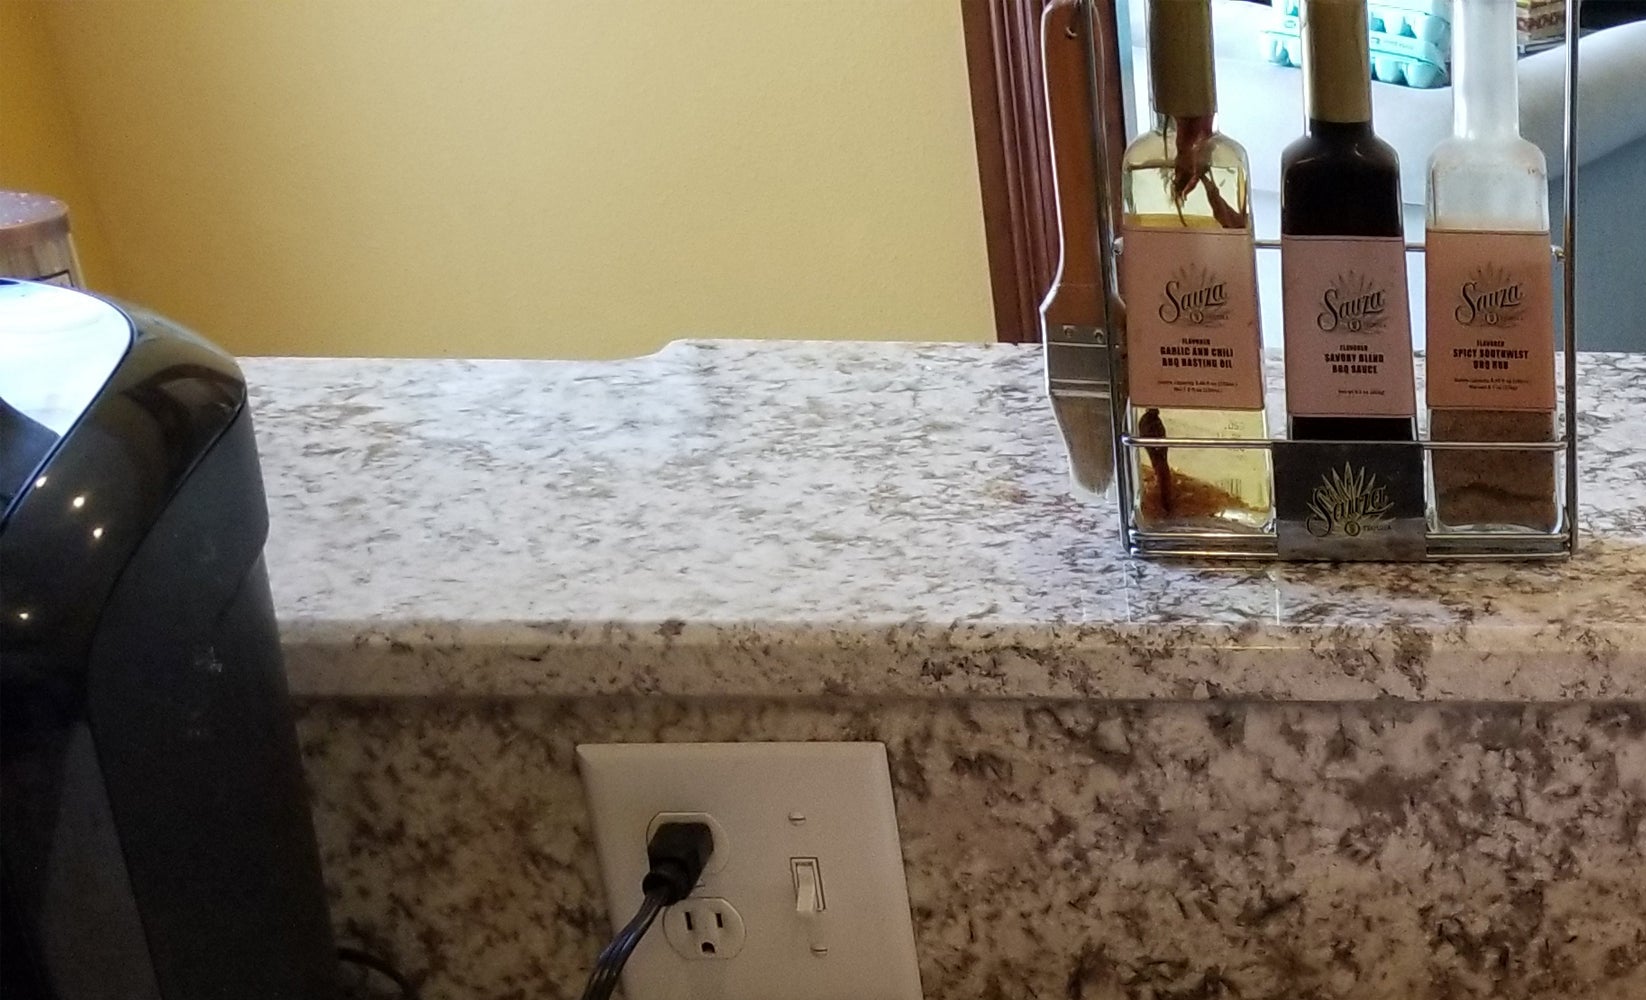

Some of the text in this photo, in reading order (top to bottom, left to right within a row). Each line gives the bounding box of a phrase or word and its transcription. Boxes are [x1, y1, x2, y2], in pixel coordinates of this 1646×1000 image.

[1159, 280, 1227, 324] Sauza
[1317, 289, 1386, 332] Sauza
[1455, 281, 1523, 326] Sauza
[1324, 353, 1384, 363] SAVORY BLEND
[1453, 348, 1529, 359] SPICY SOUTHWEST
[1332, 364, 1378, 374] BBQ SAUCE
